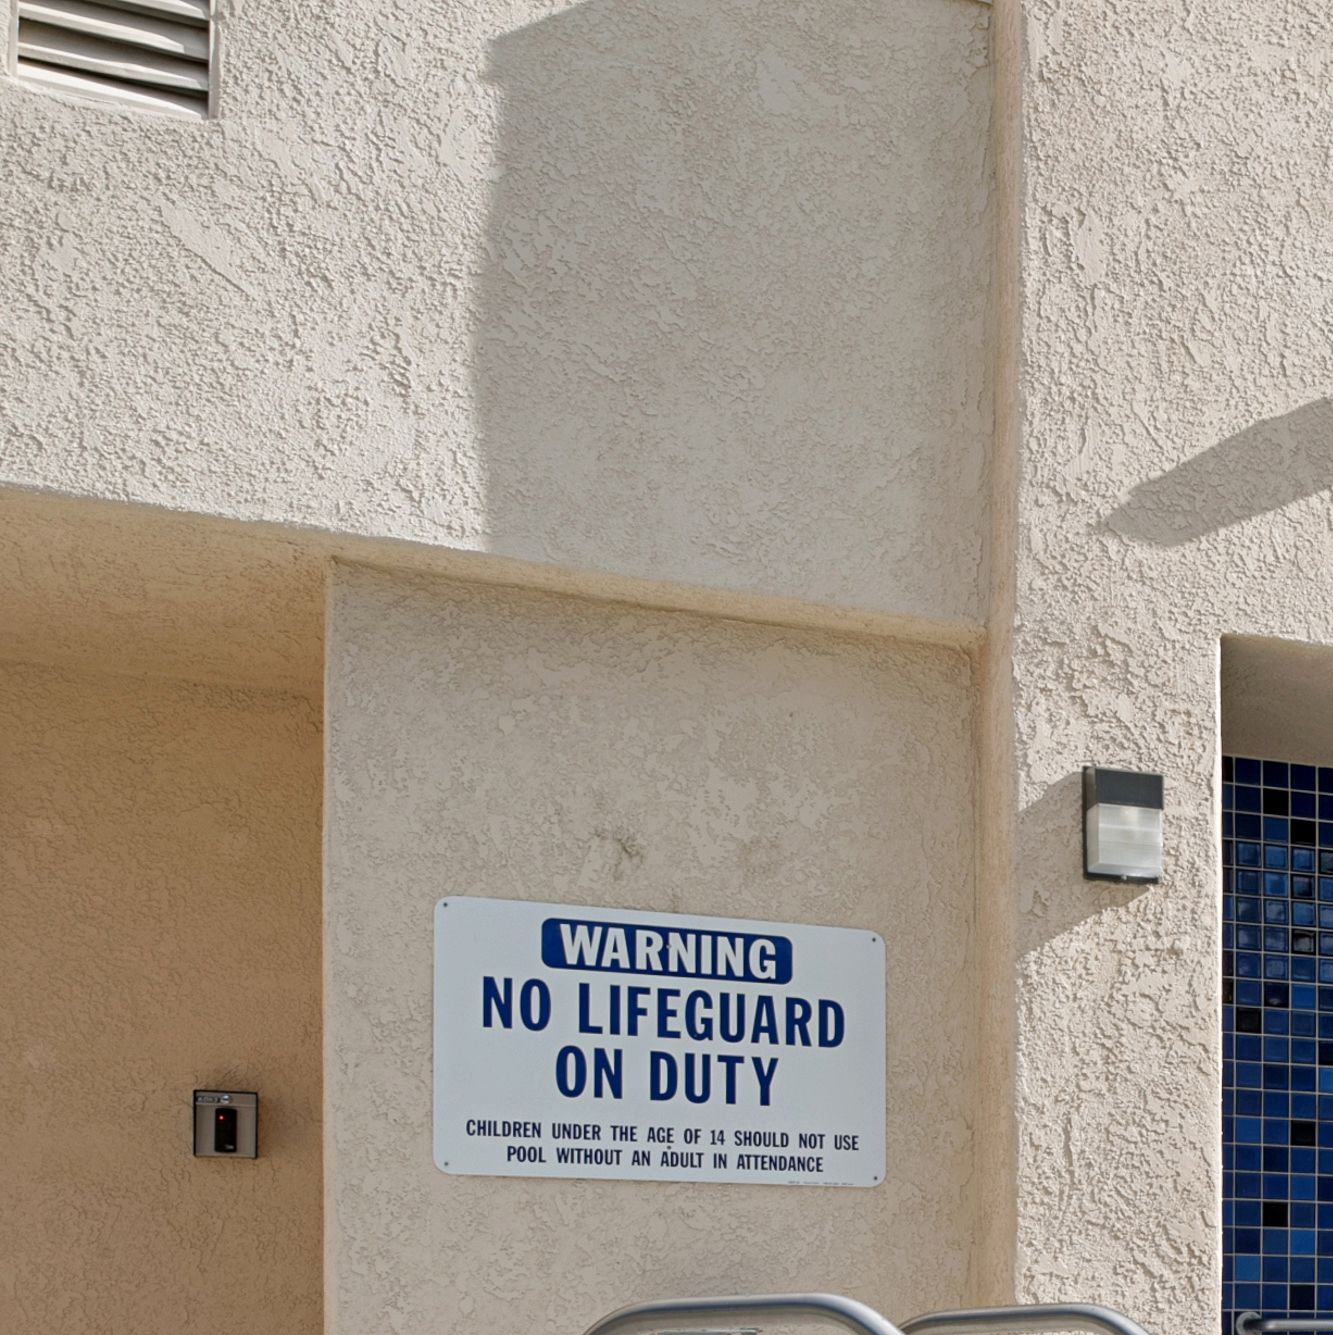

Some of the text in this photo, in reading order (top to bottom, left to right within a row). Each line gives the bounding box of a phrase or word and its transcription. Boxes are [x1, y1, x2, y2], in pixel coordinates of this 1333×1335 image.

[559, 923, 776, 980] WARNING
[482, 975, 844, 1048] NO LIFEGUARD
[555, 1044, 778, 1107] ON DUTY
[466, 1119, 859, 1150] CHILDREN UNDER THE AGE OF 14 SHOULD NOT USE
[507, 1145, 823, 1173] POOL WITHOUT AN ADULT IN ATTENDANCE
